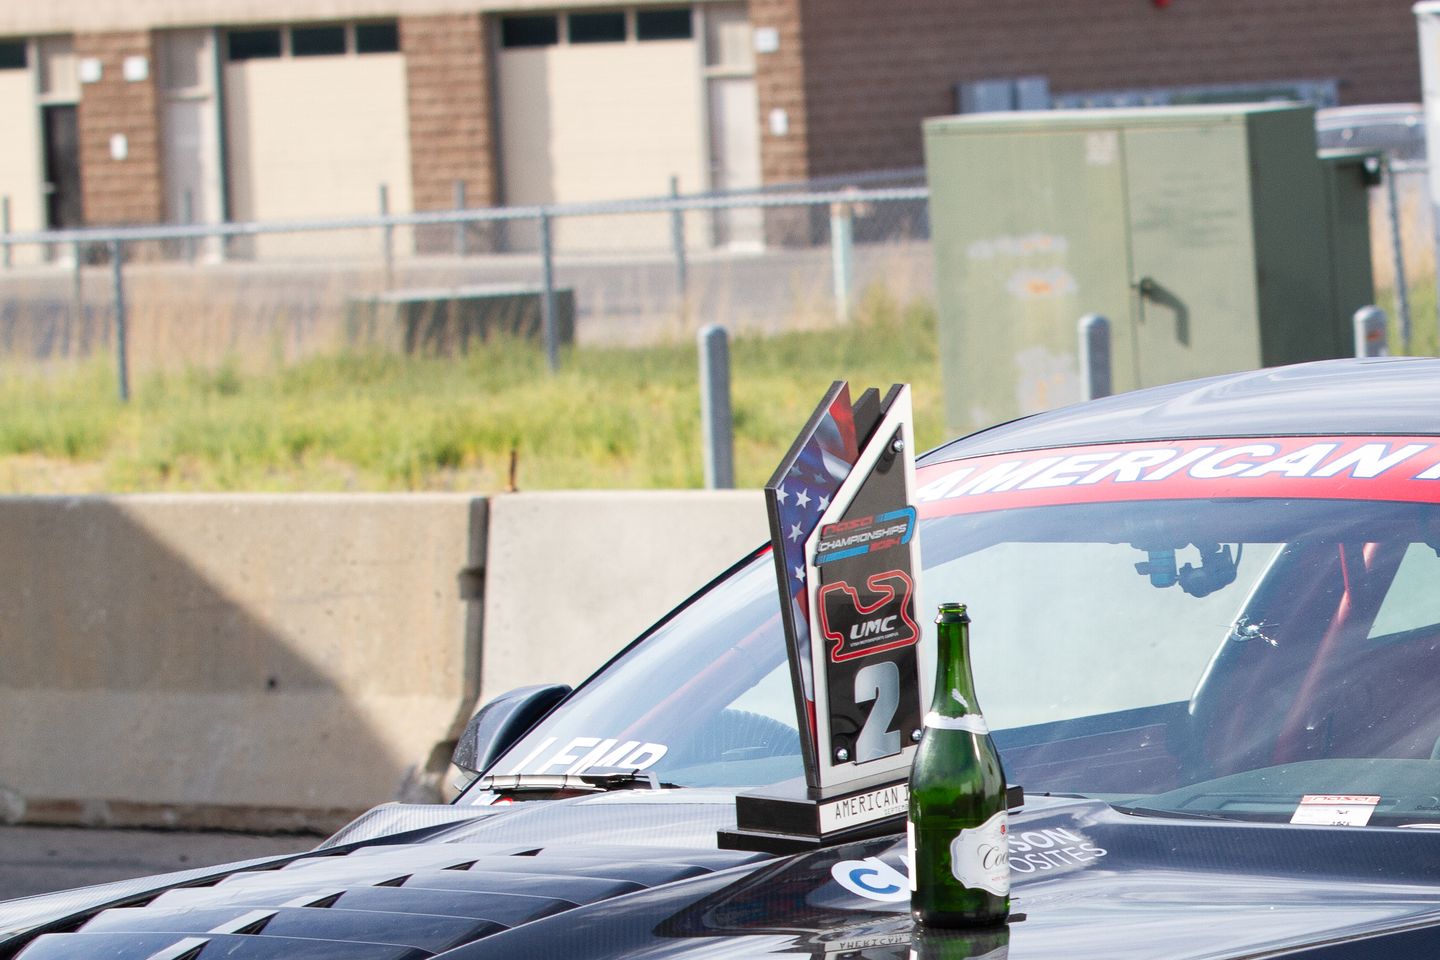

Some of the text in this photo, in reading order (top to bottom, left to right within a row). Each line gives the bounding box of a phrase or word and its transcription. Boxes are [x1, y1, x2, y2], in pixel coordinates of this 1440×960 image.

[916, 442, 1432, 502] AMERICAN
[819, 523, 907, 552] CHAMPIONSHIPS
[850, 615, 897, 640] UMC
[855, 661, 901, 764] 2
[835, 787, 899, 820] AMERICAN
